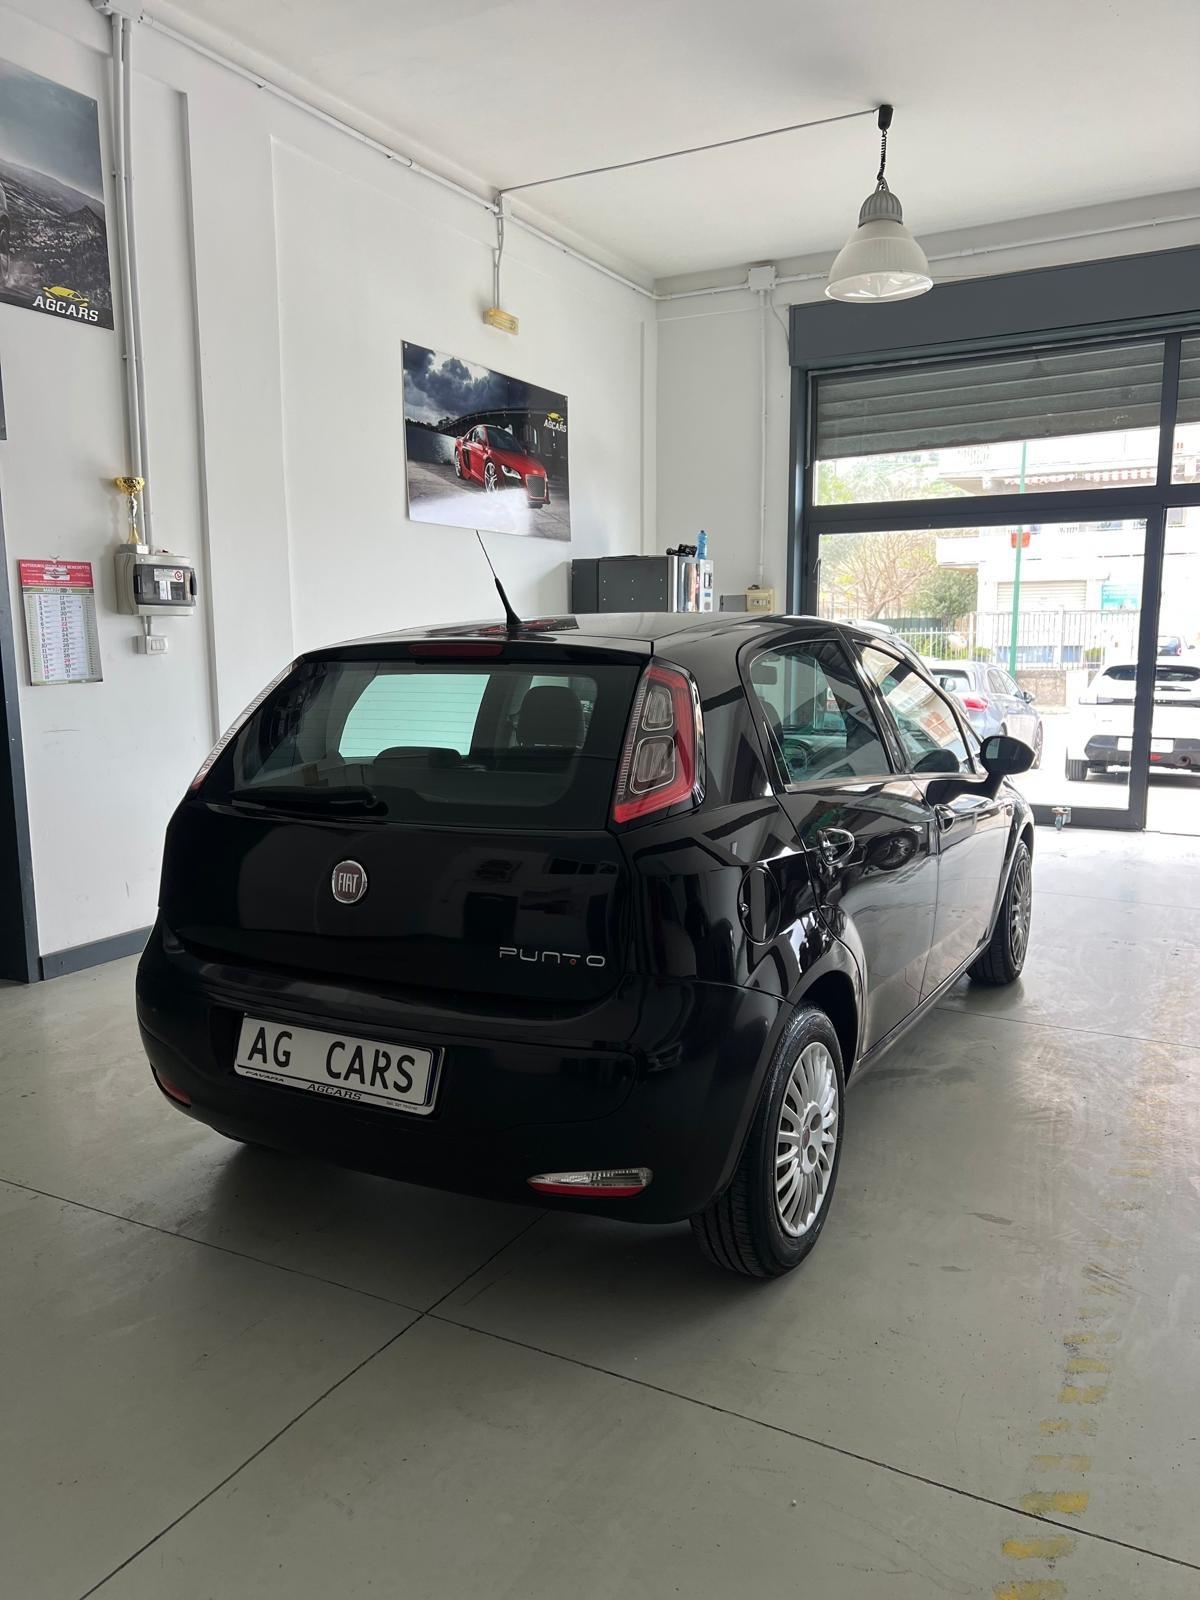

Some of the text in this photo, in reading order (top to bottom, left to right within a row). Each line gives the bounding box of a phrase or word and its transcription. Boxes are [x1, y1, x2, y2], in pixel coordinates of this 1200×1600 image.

[32, 295, 99, 322] AGCARS
[543, 419, 567, 433] AGCARS
[338, 872, 359, 893] FIAT
[499, 946, 606, 967] PUNTO
[247, 1026, 416, 1094] AG CARS
[245, 1070, 285, 1083] FAVARA
[306, 1083, 363, 1101] AGCARS
